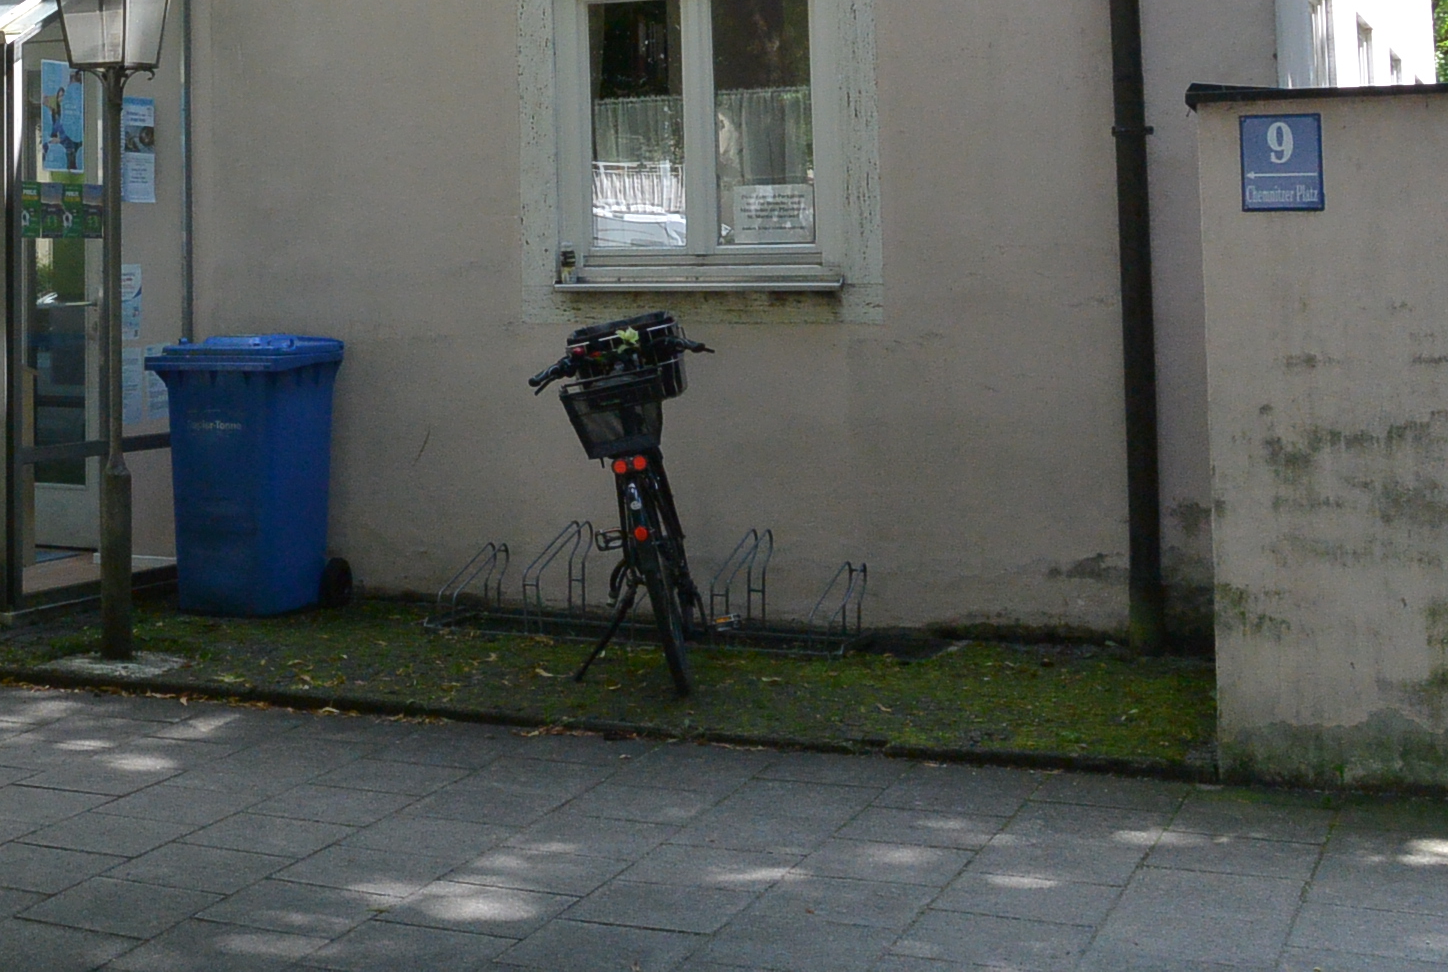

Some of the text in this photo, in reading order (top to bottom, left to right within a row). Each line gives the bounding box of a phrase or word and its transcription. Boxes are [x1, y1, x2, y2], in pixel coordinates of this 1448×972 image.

[1266, 121, 1294, 164] 9
[1245, 184, 1319, 203] Chemnitzer Platz
